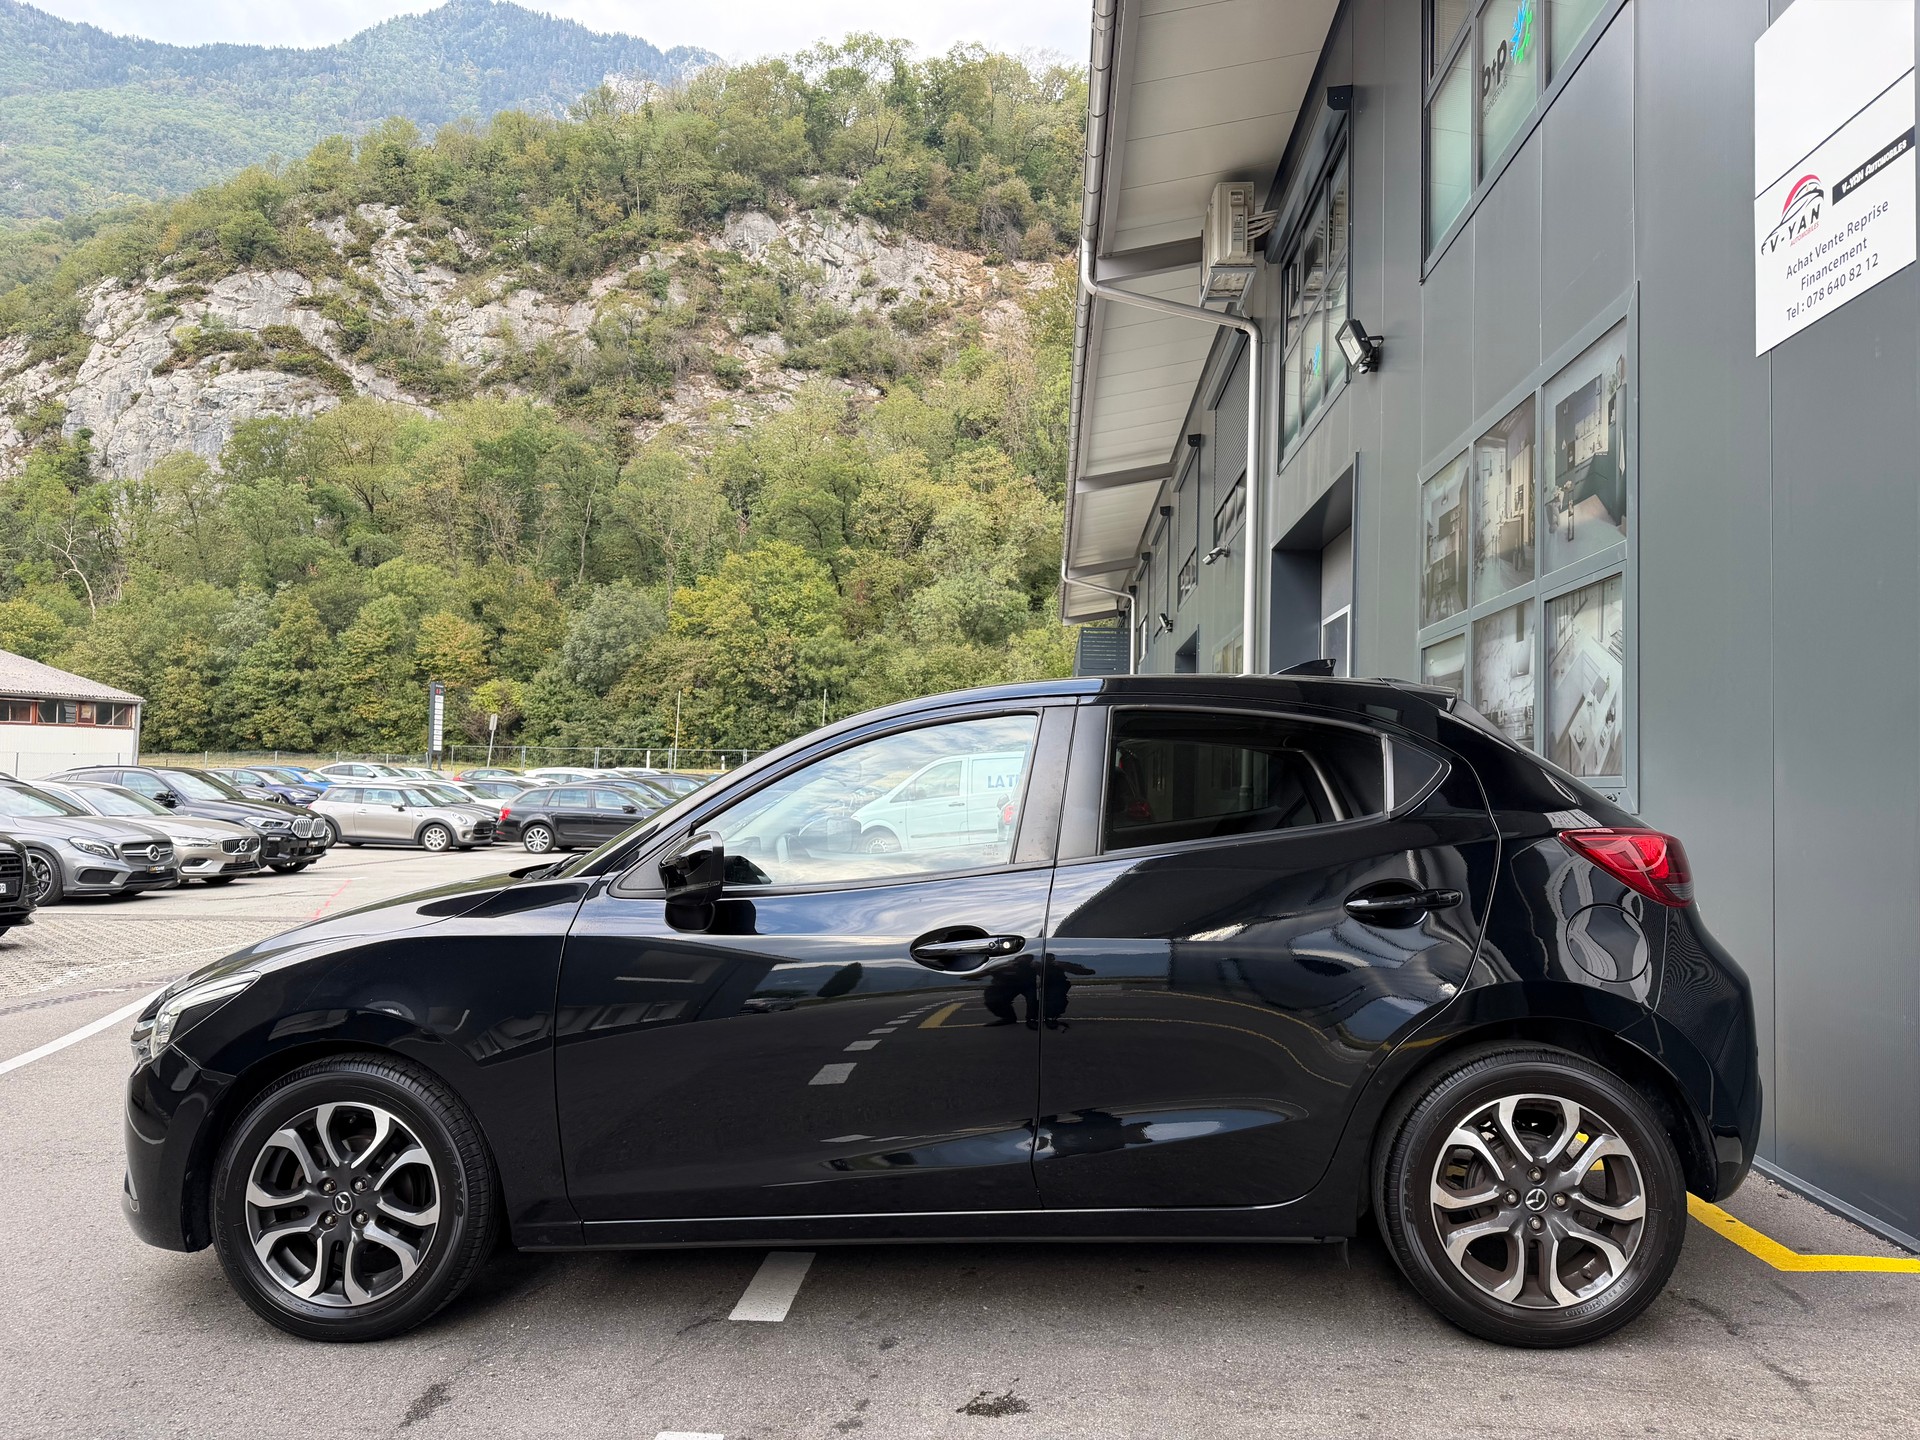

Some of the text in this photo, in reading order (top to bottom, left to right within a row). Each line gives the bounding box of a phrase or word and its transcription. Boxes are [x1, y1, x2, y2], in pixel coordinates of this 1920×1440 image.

[1841, 169, 1864, 193] V-YAN
[1770, 203, 1821, 253] V-YAN
[1786, 201, 1889, 279] Achat Vente Reprise
[1801, 237, 1867, 290] Financement
[1806, 287, 1825, 308] 078
[1827, 273, 1846, 295] 640
[1849, 263, 1862, 282] 82
[1865, 252, 1879, 271] 12
